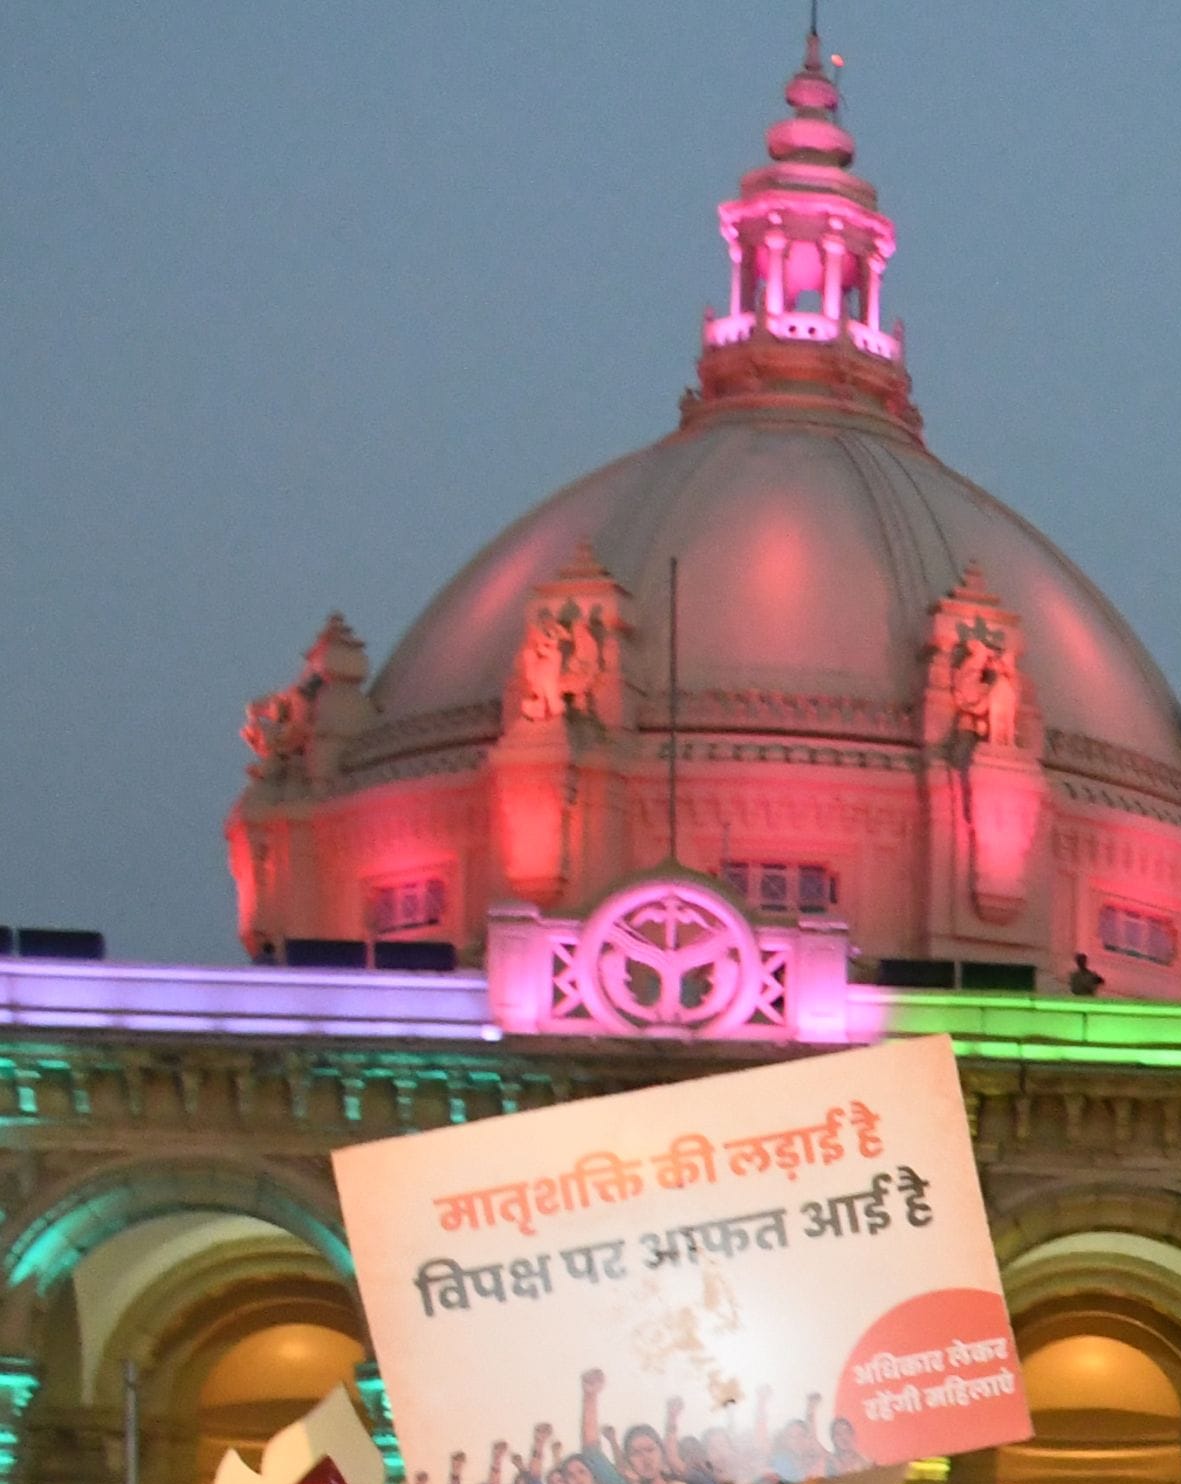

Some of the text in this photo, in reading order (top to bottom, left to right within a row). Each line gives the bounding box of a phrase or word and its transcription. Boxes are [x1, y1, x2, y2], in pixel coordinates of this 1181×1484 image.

[432, 1099, 884, 1237] मातृशक्ति की लड़ाई है
[413, 1165, 934, 1318] विपक्ष पर आफत आई है
[853, 1337, 1009, 1386] अधिकार लेकर
